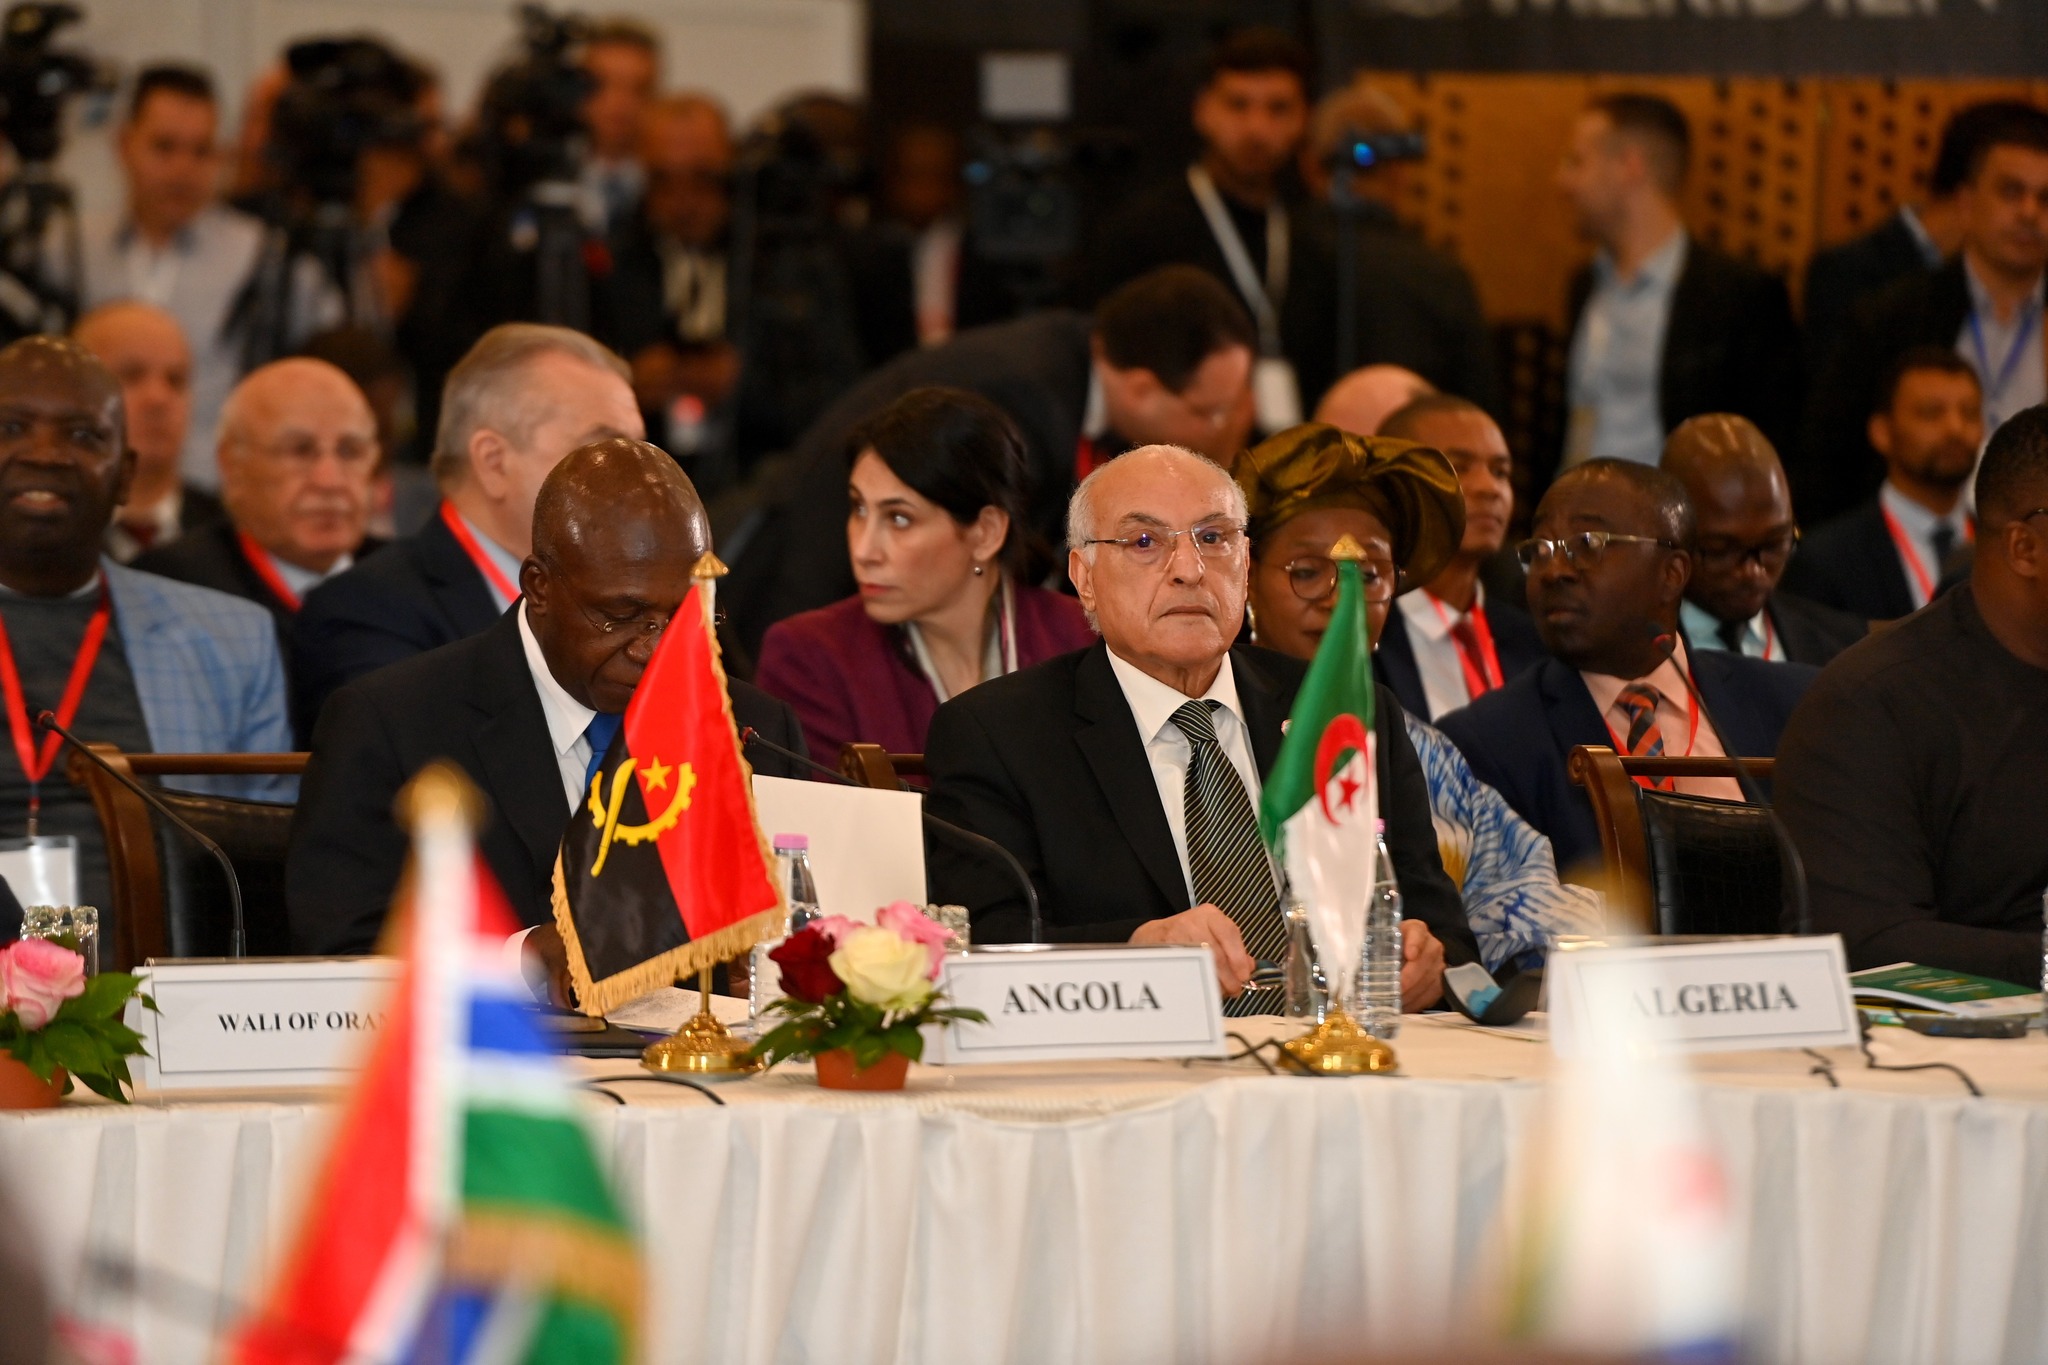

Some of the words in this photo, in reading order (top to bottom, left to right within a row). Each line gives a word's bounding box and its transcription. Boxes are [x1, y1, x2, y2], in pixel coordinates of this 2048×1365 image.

[1002, 981, 1162, 1013] ANGOLA
[217, 1012, 281, 1032] WALI
[288, 1011, 319, 1031] OF
